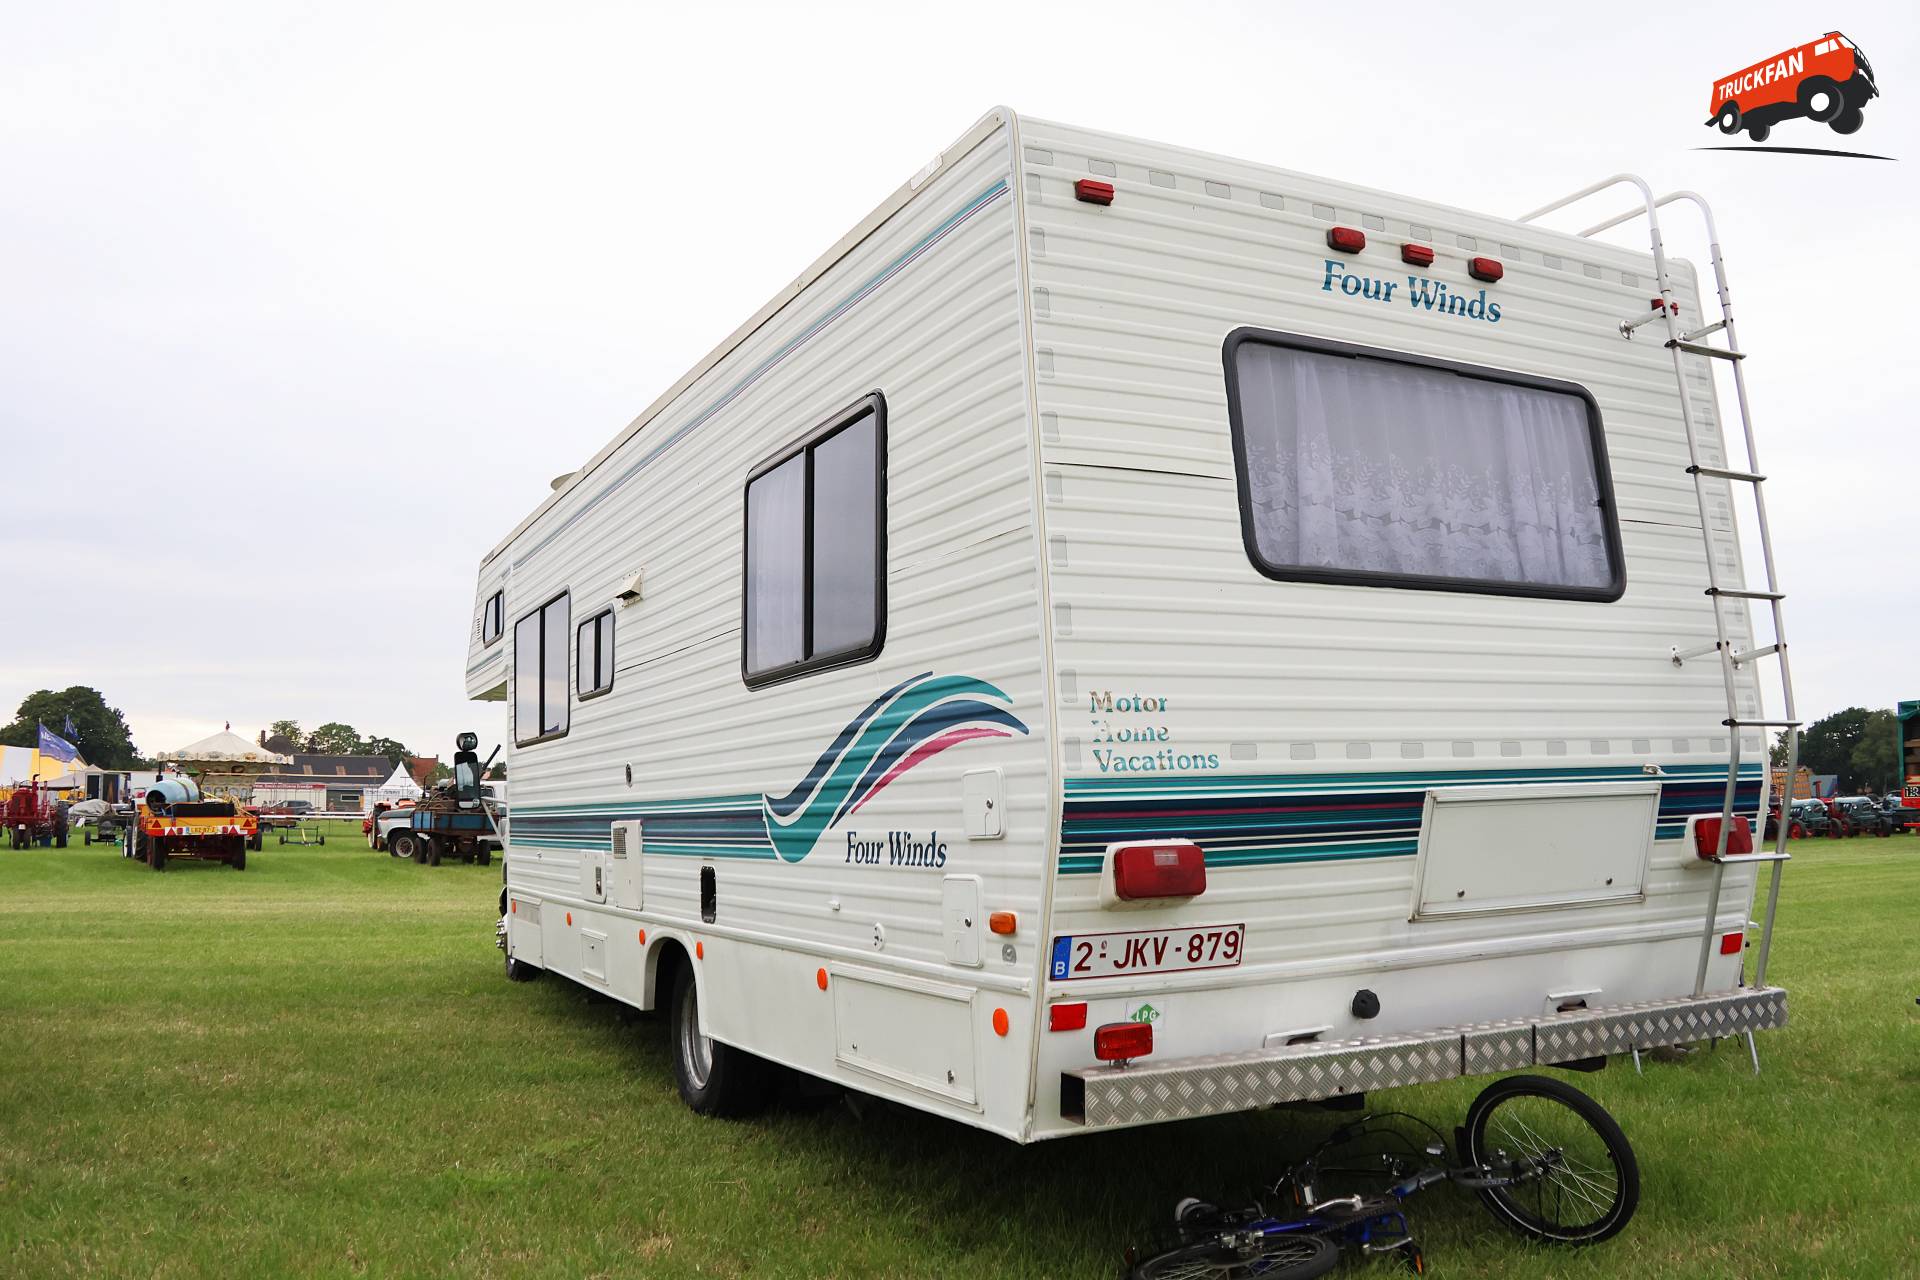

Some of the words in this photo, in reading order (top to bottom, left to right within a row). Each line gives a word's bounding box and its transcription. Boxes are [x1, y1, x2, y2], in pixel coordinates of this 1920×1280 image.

[1321, 259, 1398, 303] Four
[1407, 276, 1502, 323] Winds
[1088, 690, 1168, 713] Motor
[1092, 748, 1220, 773] Vacations
[845, 831, 884, 865] Four
[888, 830, 948, 868] Winds
[1054, 960, 1066, 976] B
[1135, 1009, 1157, 1022] LPG
